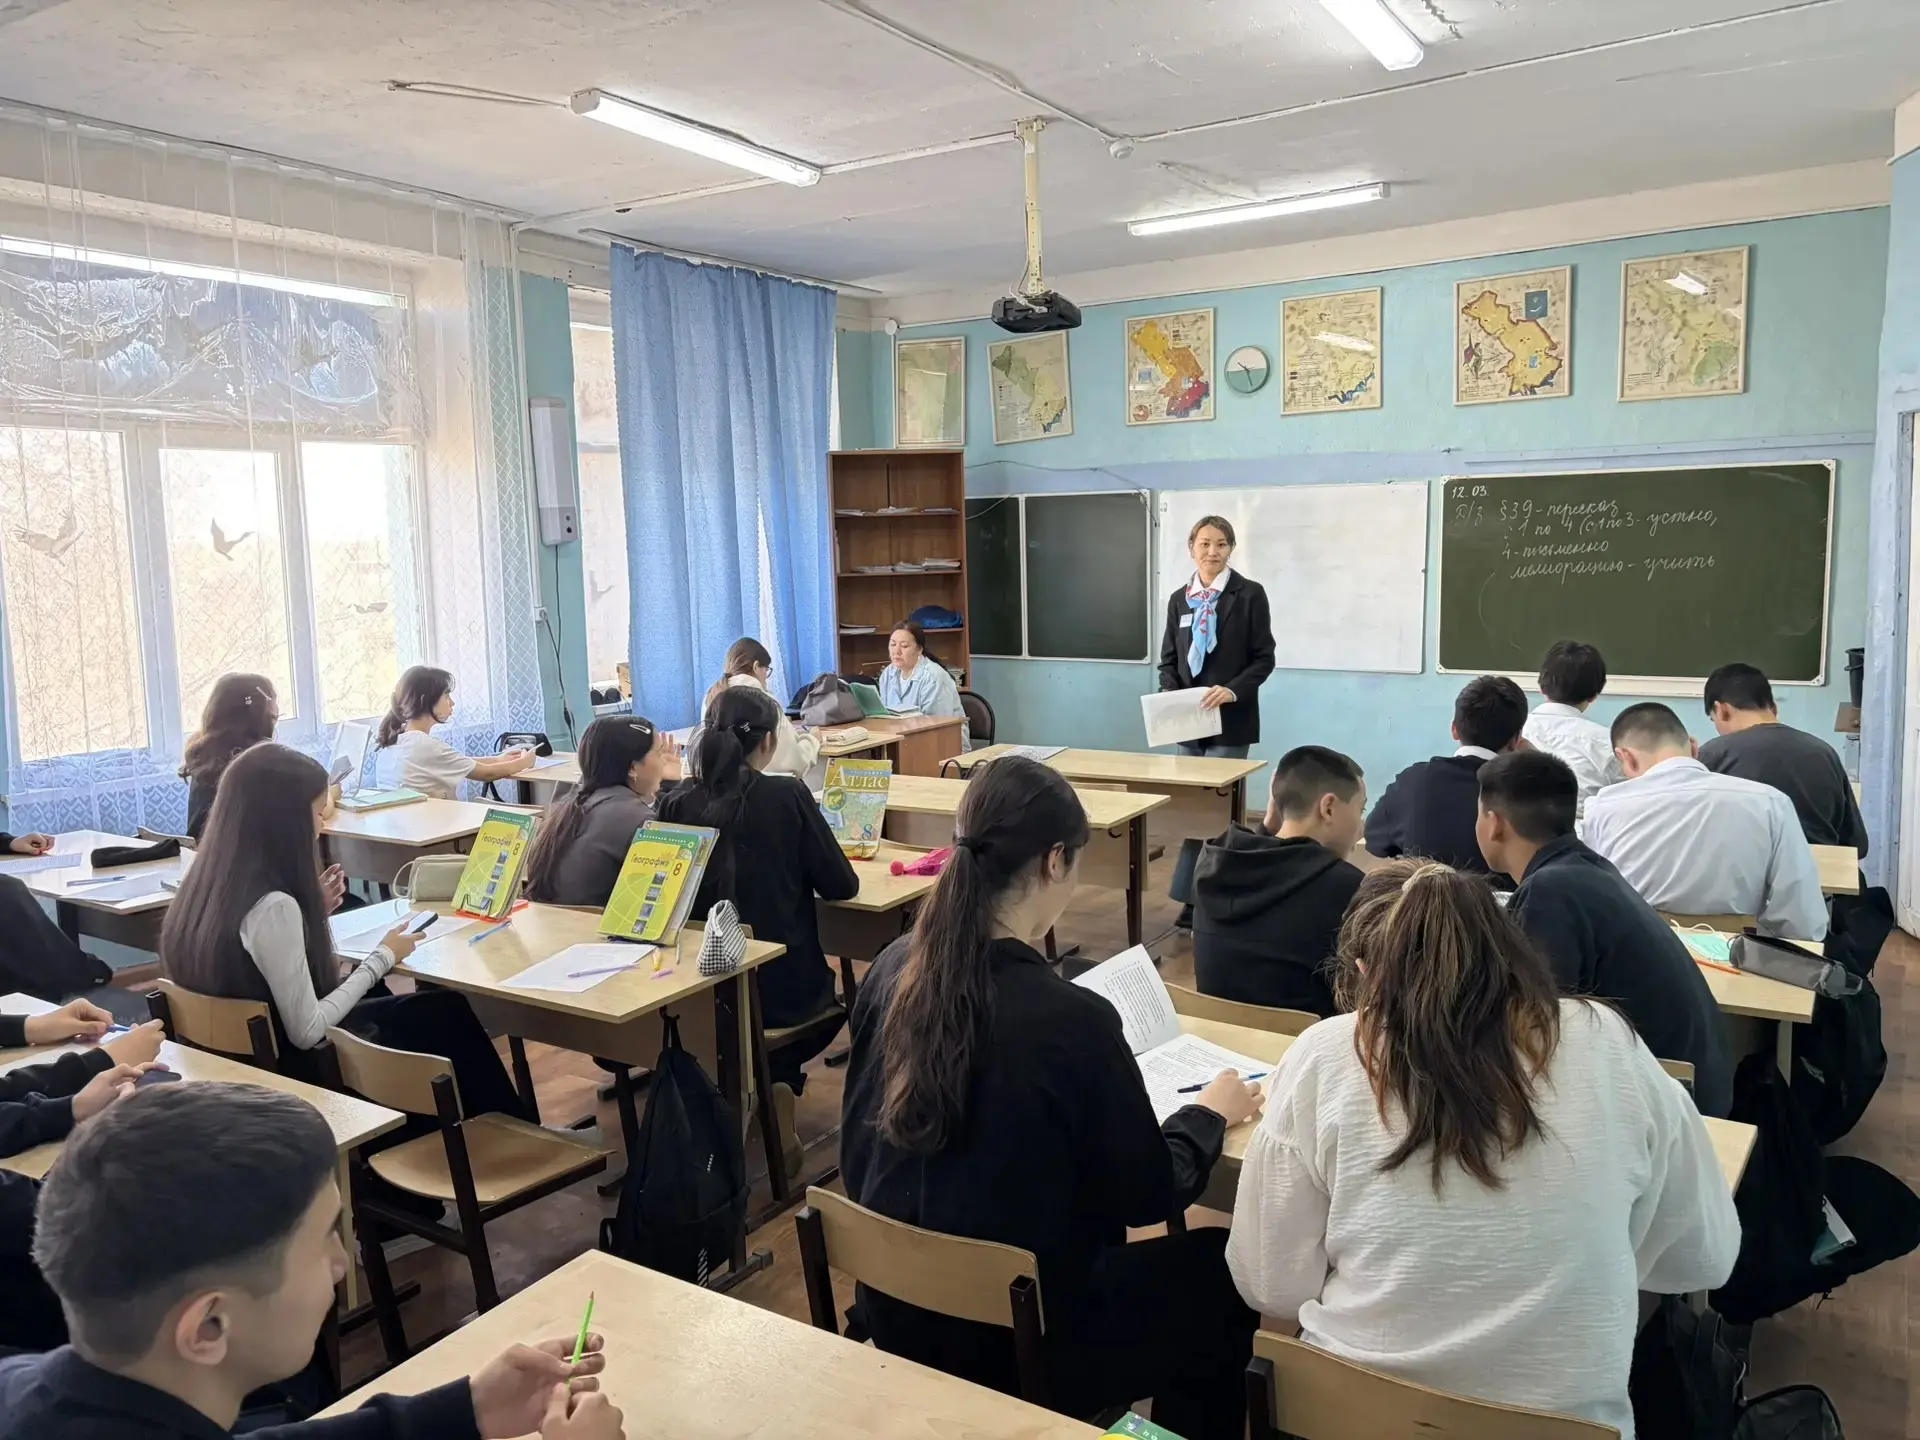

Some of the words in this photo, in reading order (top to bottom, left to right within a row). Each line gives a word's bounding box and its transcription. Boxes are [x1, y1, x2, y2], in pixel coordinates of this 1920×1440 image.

[829, 764, 889, 789] Атлас
[861, 823, 874, 841] 8
[512, 842, 521, 856] 8
[631, 853, 671, 869] География
[672, 862, 683, 877] 8
